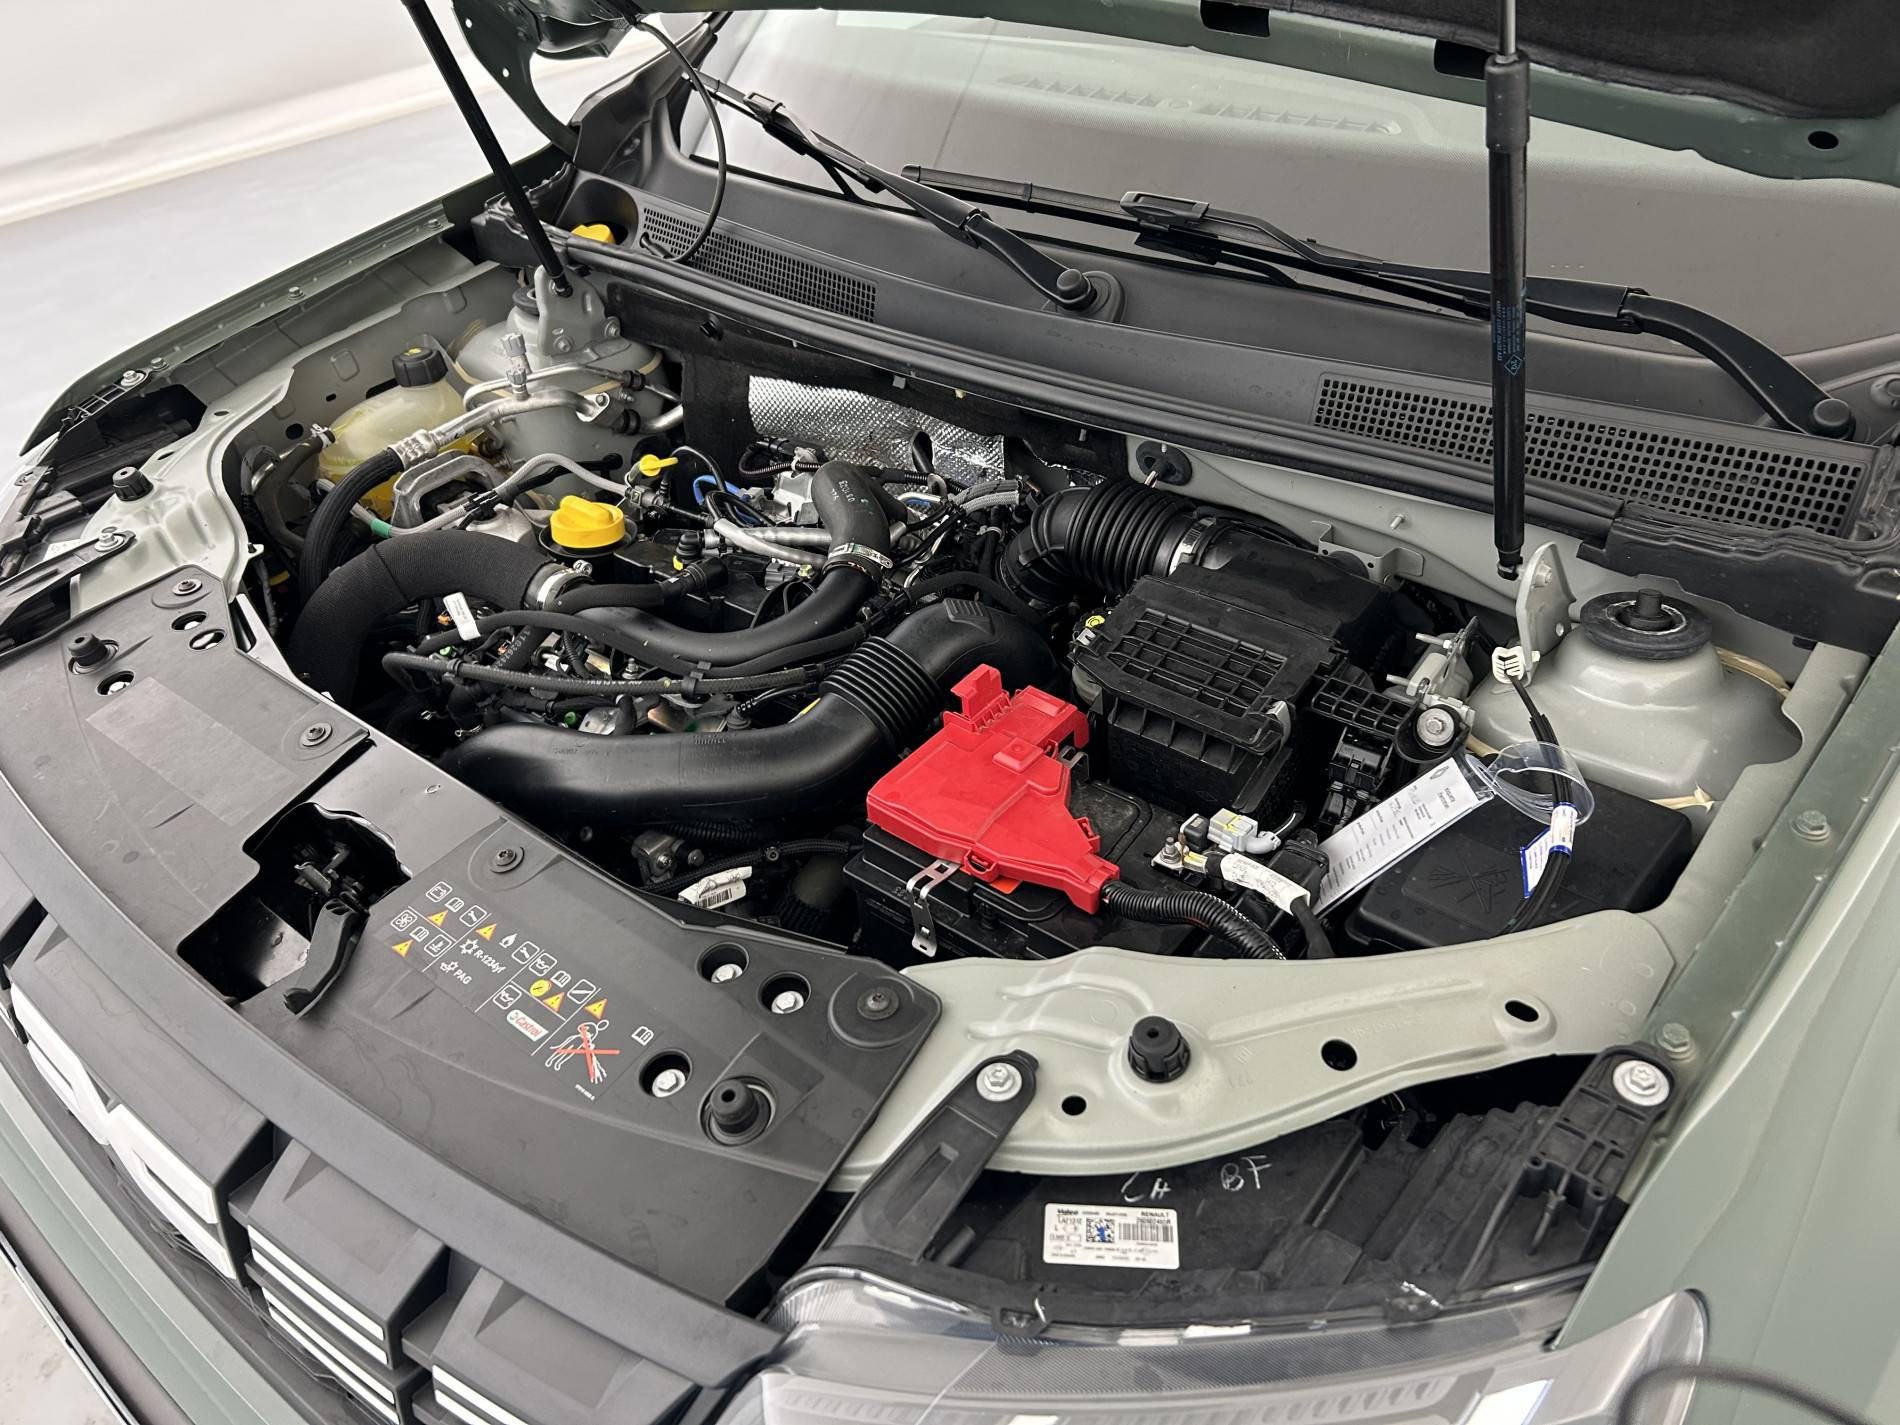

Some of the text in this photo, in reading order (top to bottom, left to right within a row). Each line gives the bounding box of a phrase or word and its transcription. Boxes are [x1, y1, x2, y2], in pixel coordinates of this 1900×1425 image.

[453, 968, 473, 985] PAG
[515, 1016, 543, 1038] Castrol
[1140, 1210, 1170, 1218] RENAULT
